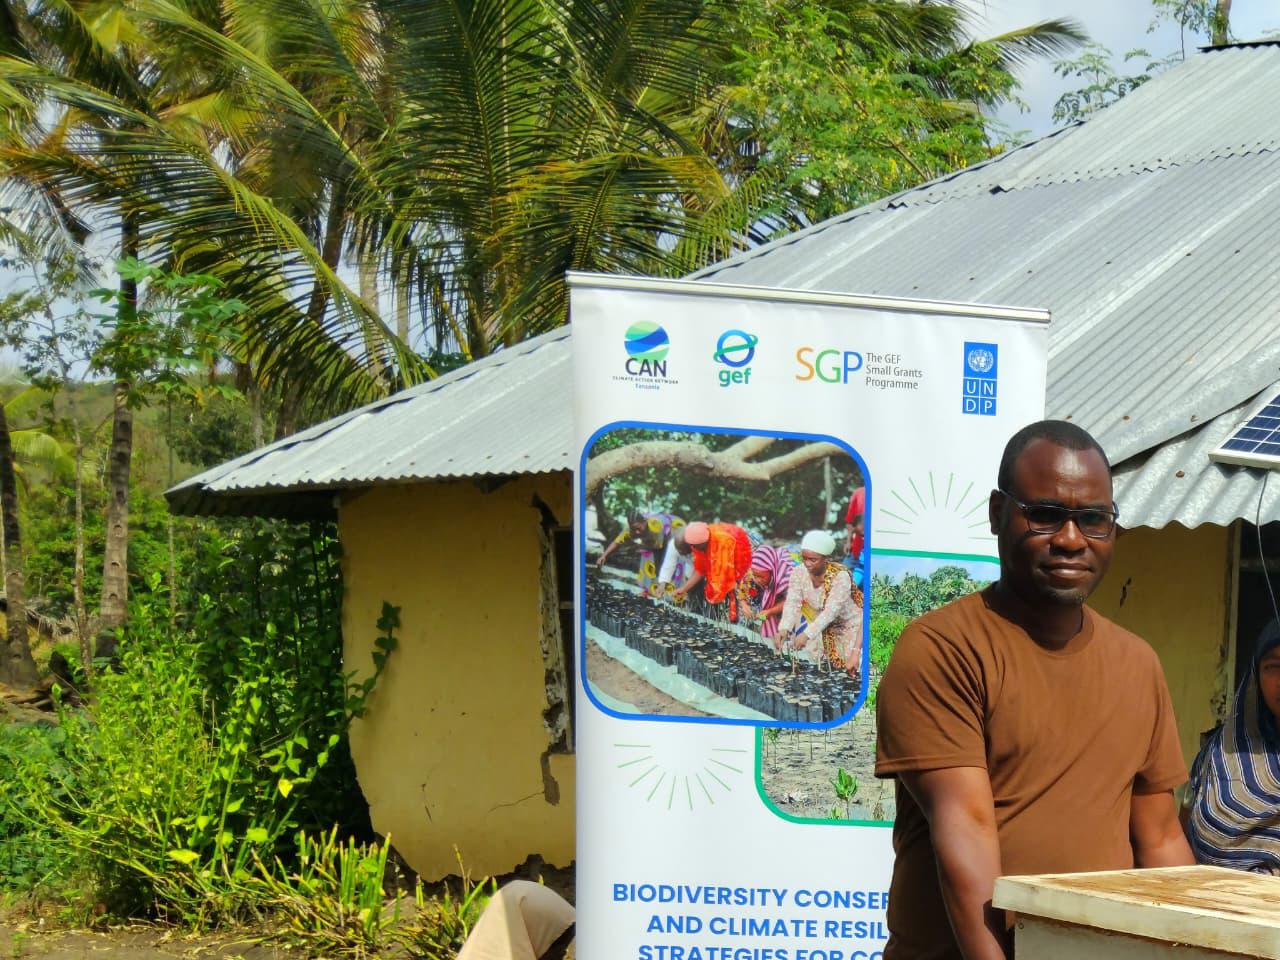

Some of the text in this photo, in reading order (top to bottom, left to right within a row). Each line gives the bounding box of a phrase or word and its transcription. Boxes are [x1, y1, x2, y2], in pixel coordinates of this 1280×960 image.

[625, 358, 667, 377] CAN
[795, 346, 863, 384] SGP
[866, 352, 902, 365] The GEF
[718, 367, 751, 387] gef
[866, 364, 923, 378] Small Grants
[865, 376, 919, 390] Programme
[612, 883, 788, 907] BIODIVERSITY
[647, 915, 888, 939] AND CLIMATE RESIL
